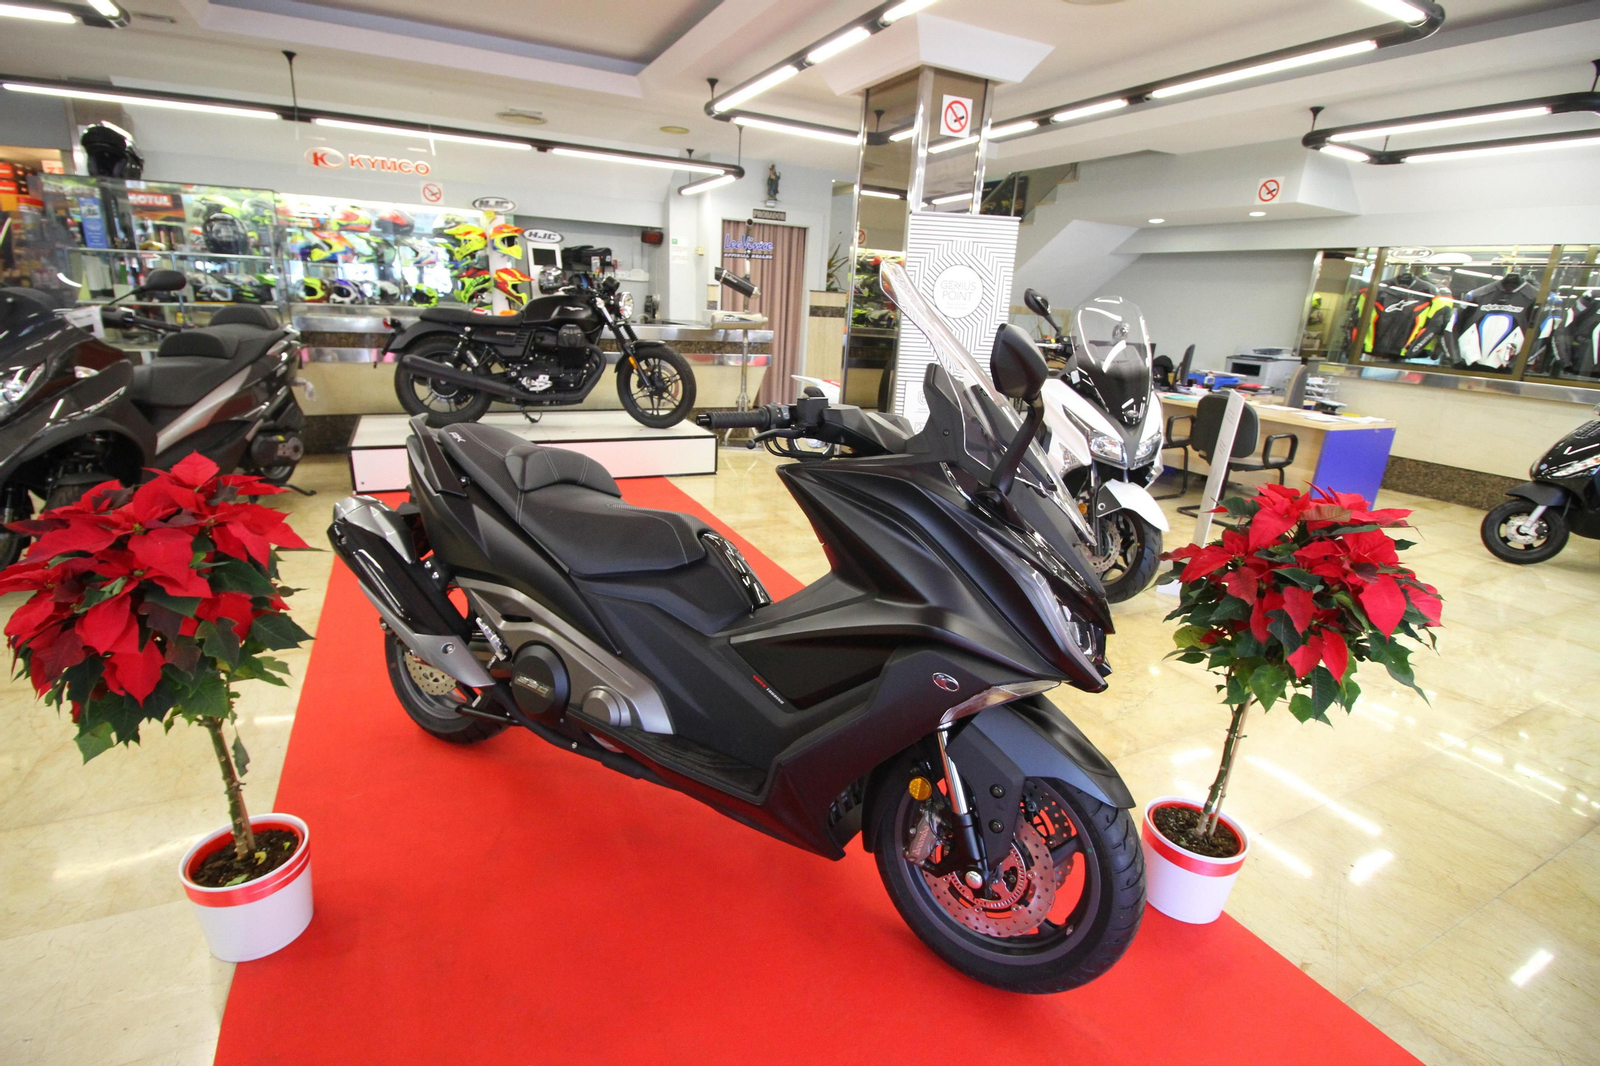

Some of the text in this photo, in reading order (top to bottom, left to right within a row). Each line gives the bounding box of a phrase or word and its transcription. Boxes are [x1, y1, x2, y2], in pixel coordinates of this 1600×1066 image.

[348, 154, 431, 176] KYMCO
[128, 193, 171, 206] MOTUL
[478, 200, 510, 210] HJC
[527, 231, 557, 241] HJC
[940, 280, 977, 291] GENIUS
[942, 290, 974, 301] POINT
